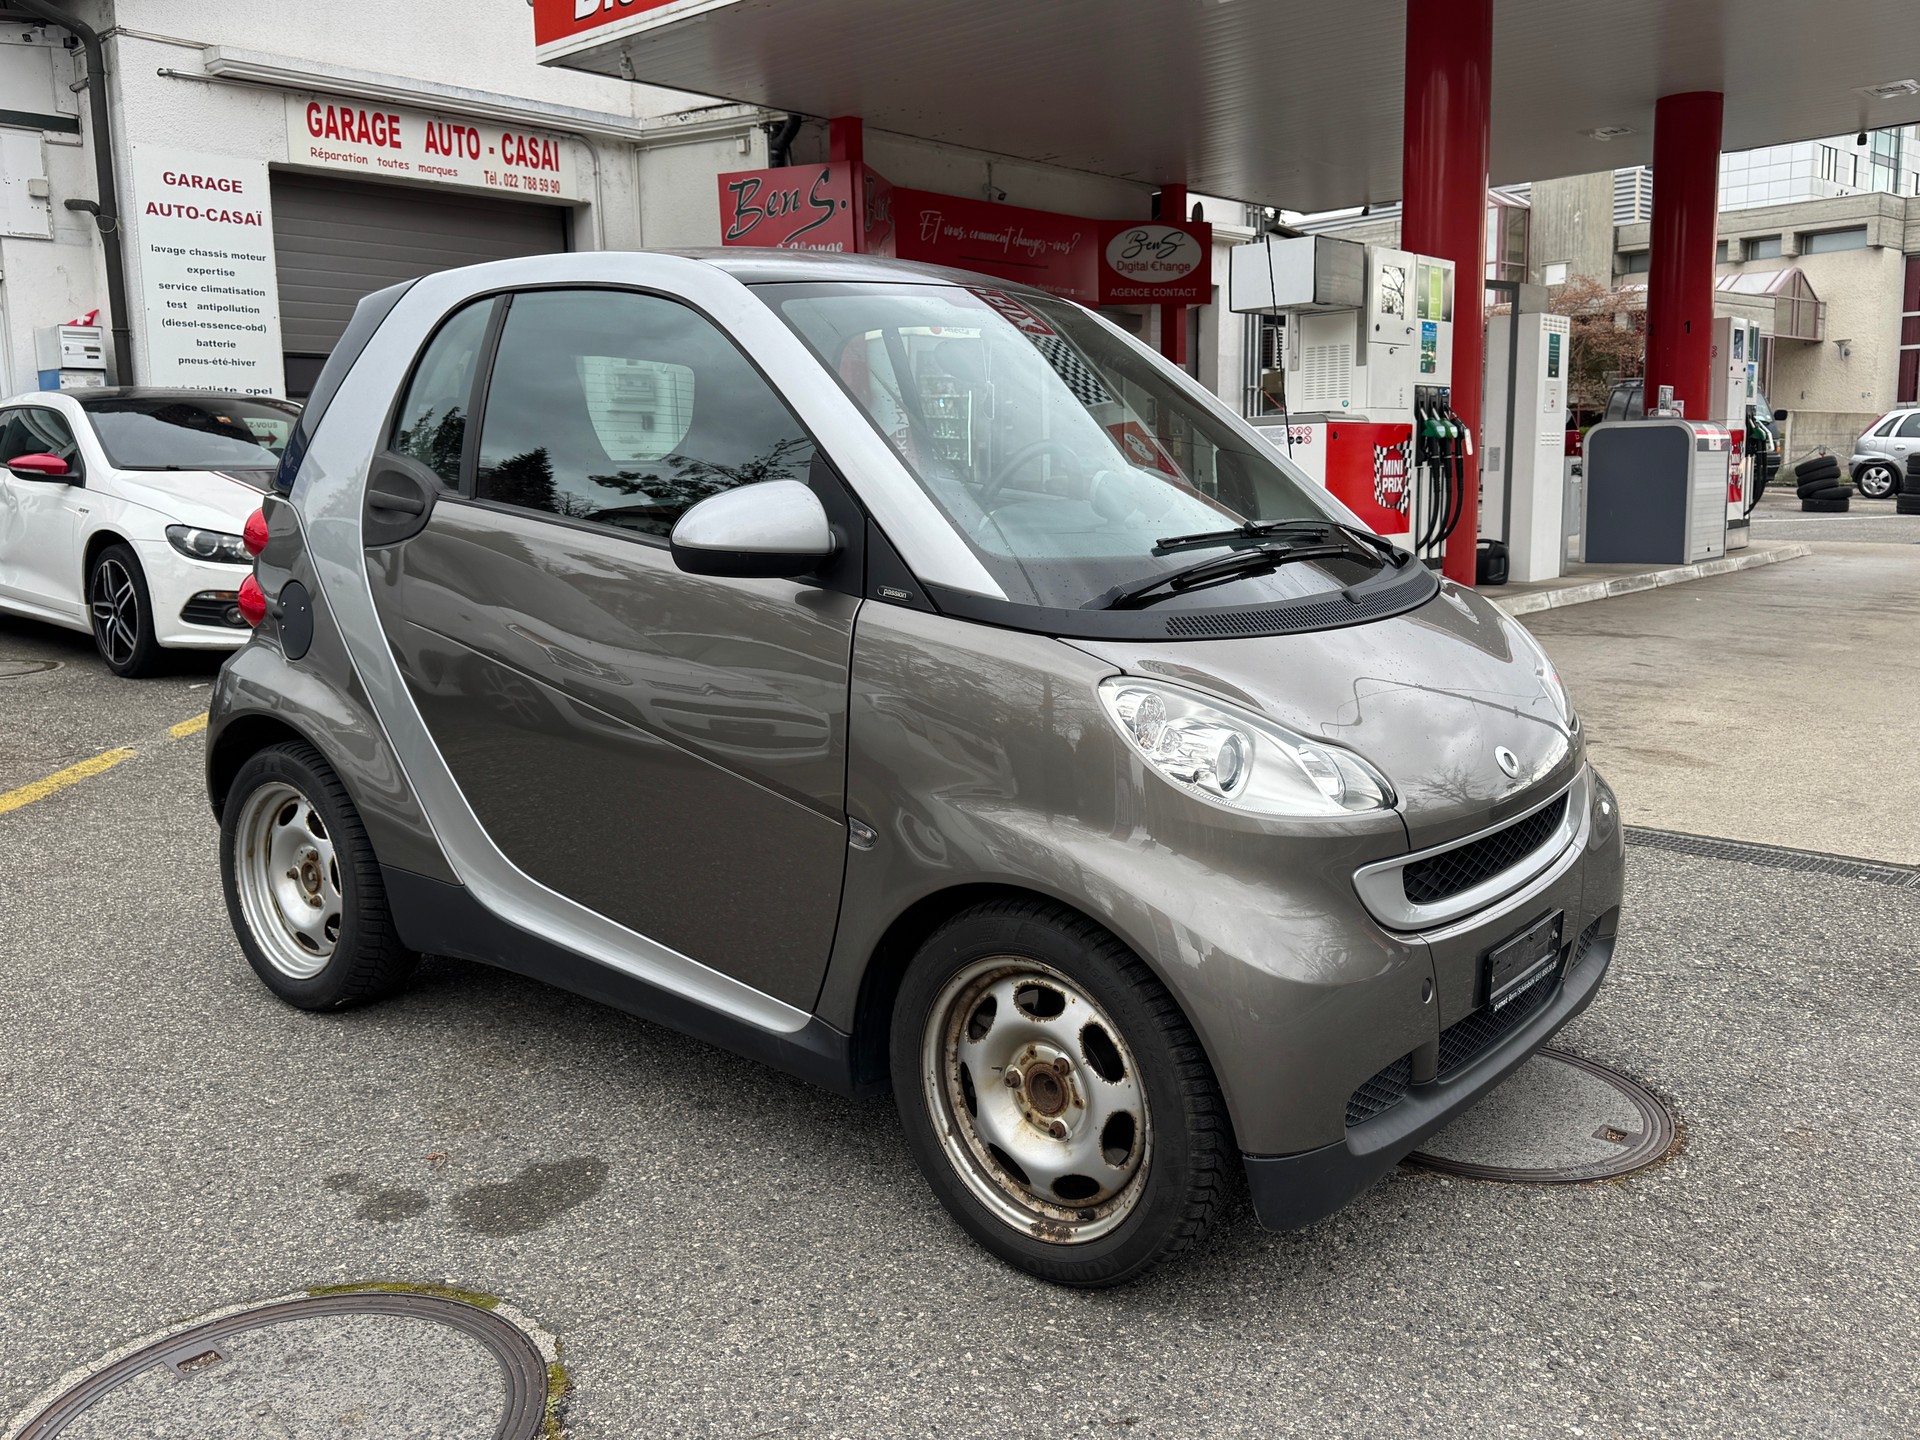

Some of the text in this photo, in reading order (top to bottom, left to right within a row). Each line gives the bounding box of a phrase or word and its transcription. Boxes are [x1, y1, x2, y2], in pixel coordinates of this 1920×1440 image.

[306, 102, 402, 149] GARAGE
[425, 120, 480, 160] AUTO
[502, 132, 560, 172] CASAI
[310, 146, 459, 178] Réparation toutes marques
[162, 171, 243, 194] GARAGE
[503, 173, 519, 188] 022
[523, 176, 538, 191] 788
[539, 178, 549, 192] 59
[550, 180, 560, 194] 90
[145, 201, 263, 226] AUTO-CASAÏ
[725, 177, 800, 240] Ben
[919, 210, 945, 245] Et
[150, 244, 267, 262] lavage chassis moteur
[186, 265, 236, 277] expertise
[1116, 260, 1148, 274] Digital
[158, 282, 266, 297] service climatisation
[1110, 287, 1197, 298] AGENCE CONTACT
[166, 300, 260, 314] test antipollution
[973, 288, 1047, 332] RIX
[161, 318, 267, 334] (diesel-essence-obd)
[1683, 320, 1691, 335] 1
[196, 339, 237, 349] batterie
[178, 357, 257, 367] pneus-été-hiver
[245, 387, 273, 396] opel
[246, 421, 278, 429] Z-VOUS
[1382, 459, 1404, 476] MINI
[1381, 476, 1404, 493] PRIX
[883, 588, 907, 599] passion
